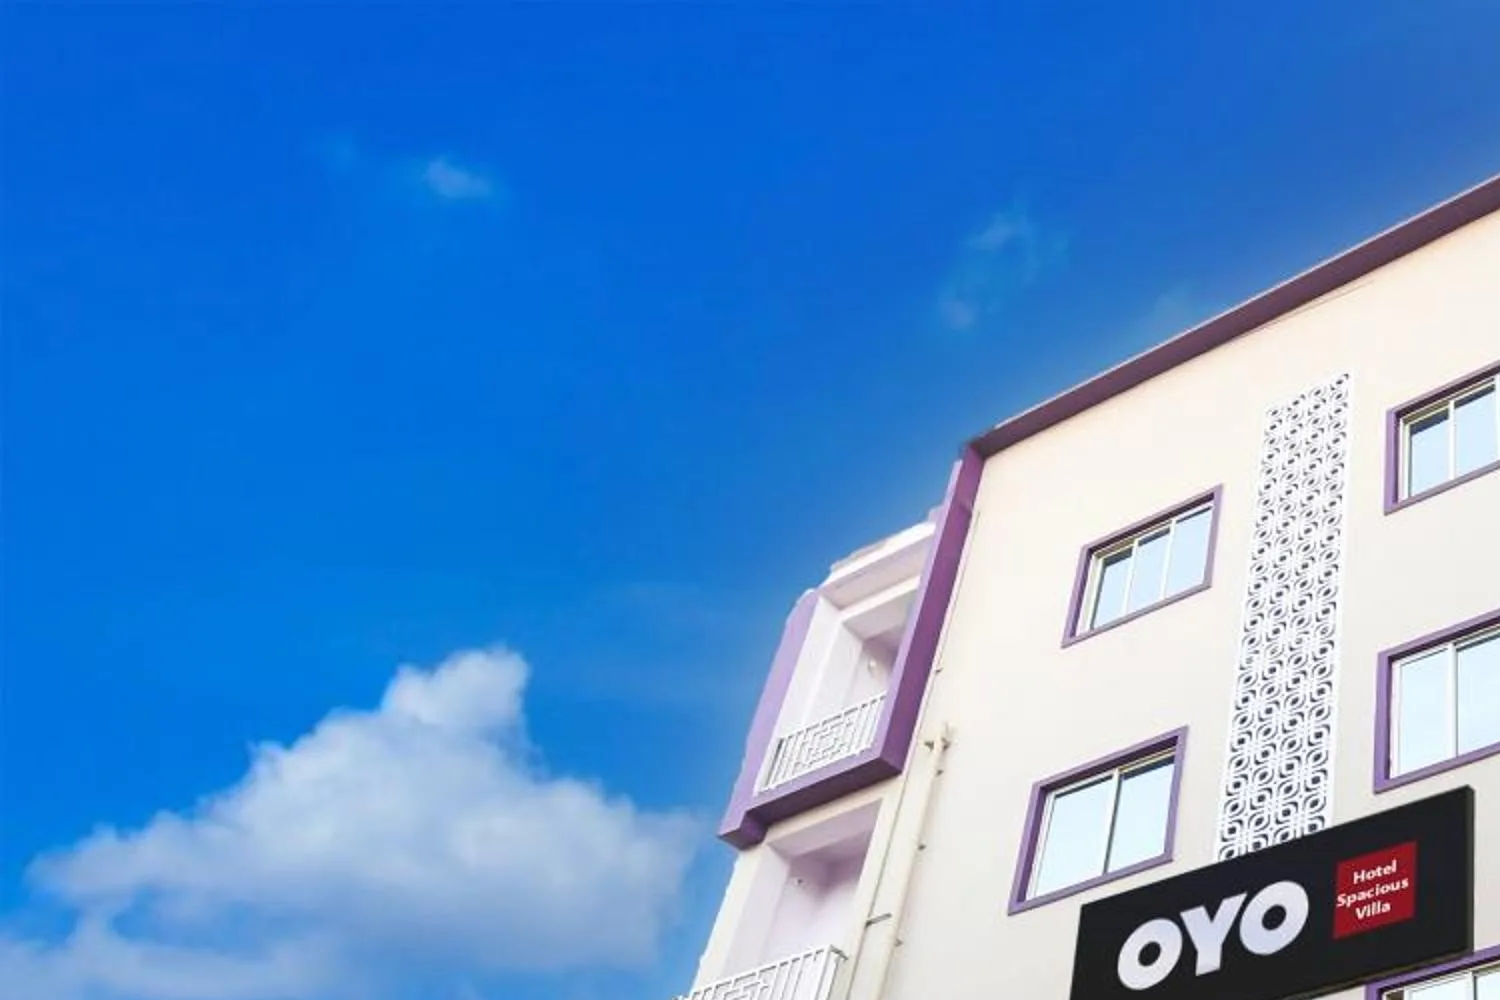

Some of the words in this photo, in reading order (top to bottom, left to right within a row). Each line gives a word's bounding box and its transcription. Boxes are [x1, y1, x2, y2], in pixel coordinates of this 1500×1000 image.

[1353, 858, 1397, 885] Hotel
[1336, 878, 1409, 908] Spacious
[1355, 900, 1391, 920] Villa
[1116, 880, 1310, 991] OYO
